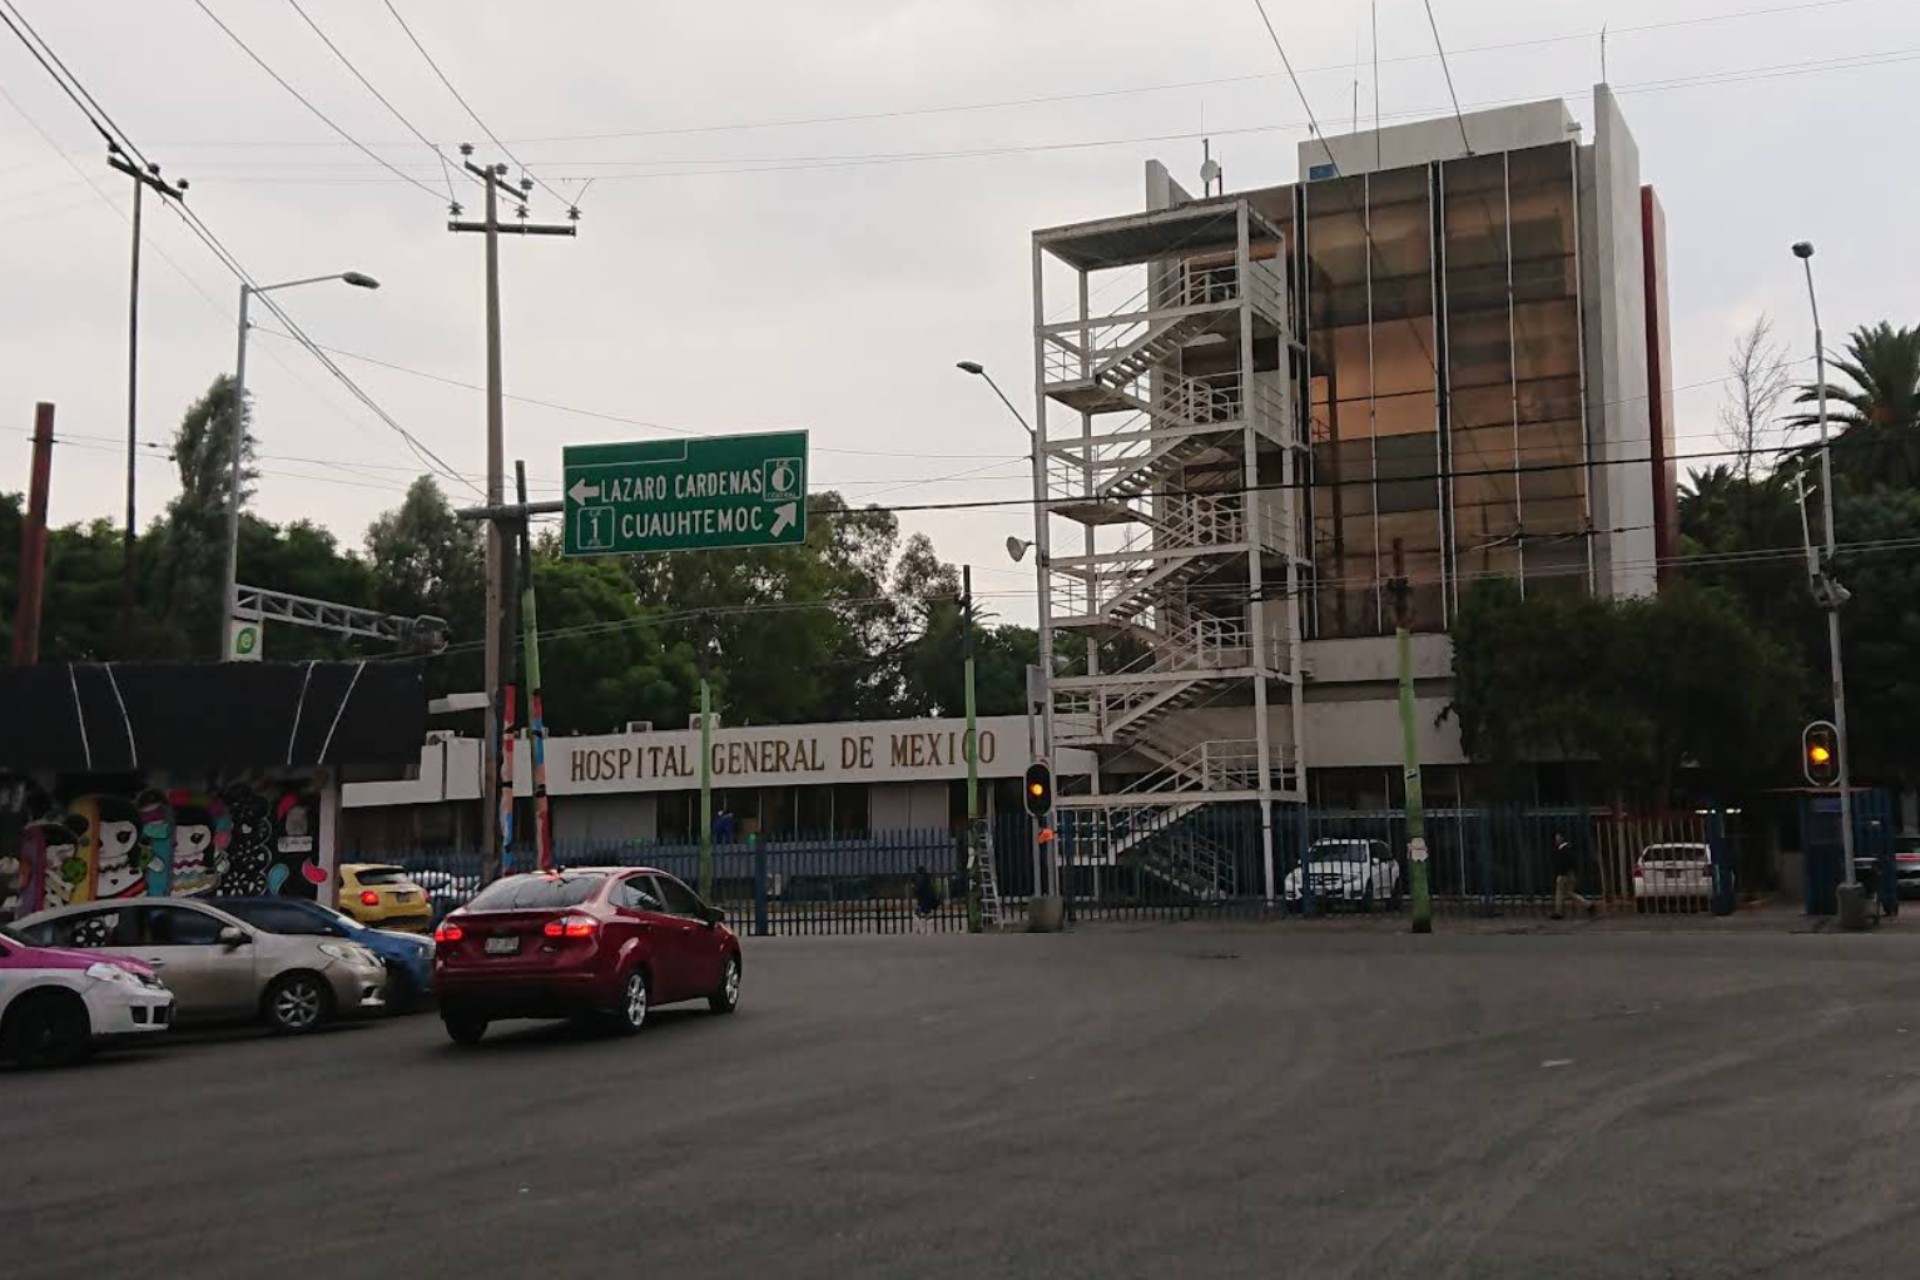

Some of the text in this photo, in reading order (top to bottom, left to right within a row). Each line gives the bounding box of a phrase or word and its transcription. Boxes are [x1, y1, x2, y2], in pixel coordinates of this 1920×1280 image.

[601, 469, 763, 503] LAZARO CARDENAS
[621, 506, 763, 539] CUAUHTEMOC
[571, 745, 695, 782] HOSPITAL
[711, 739, 825, 775] GENERAL
[841, 736, 874, 770] DE
